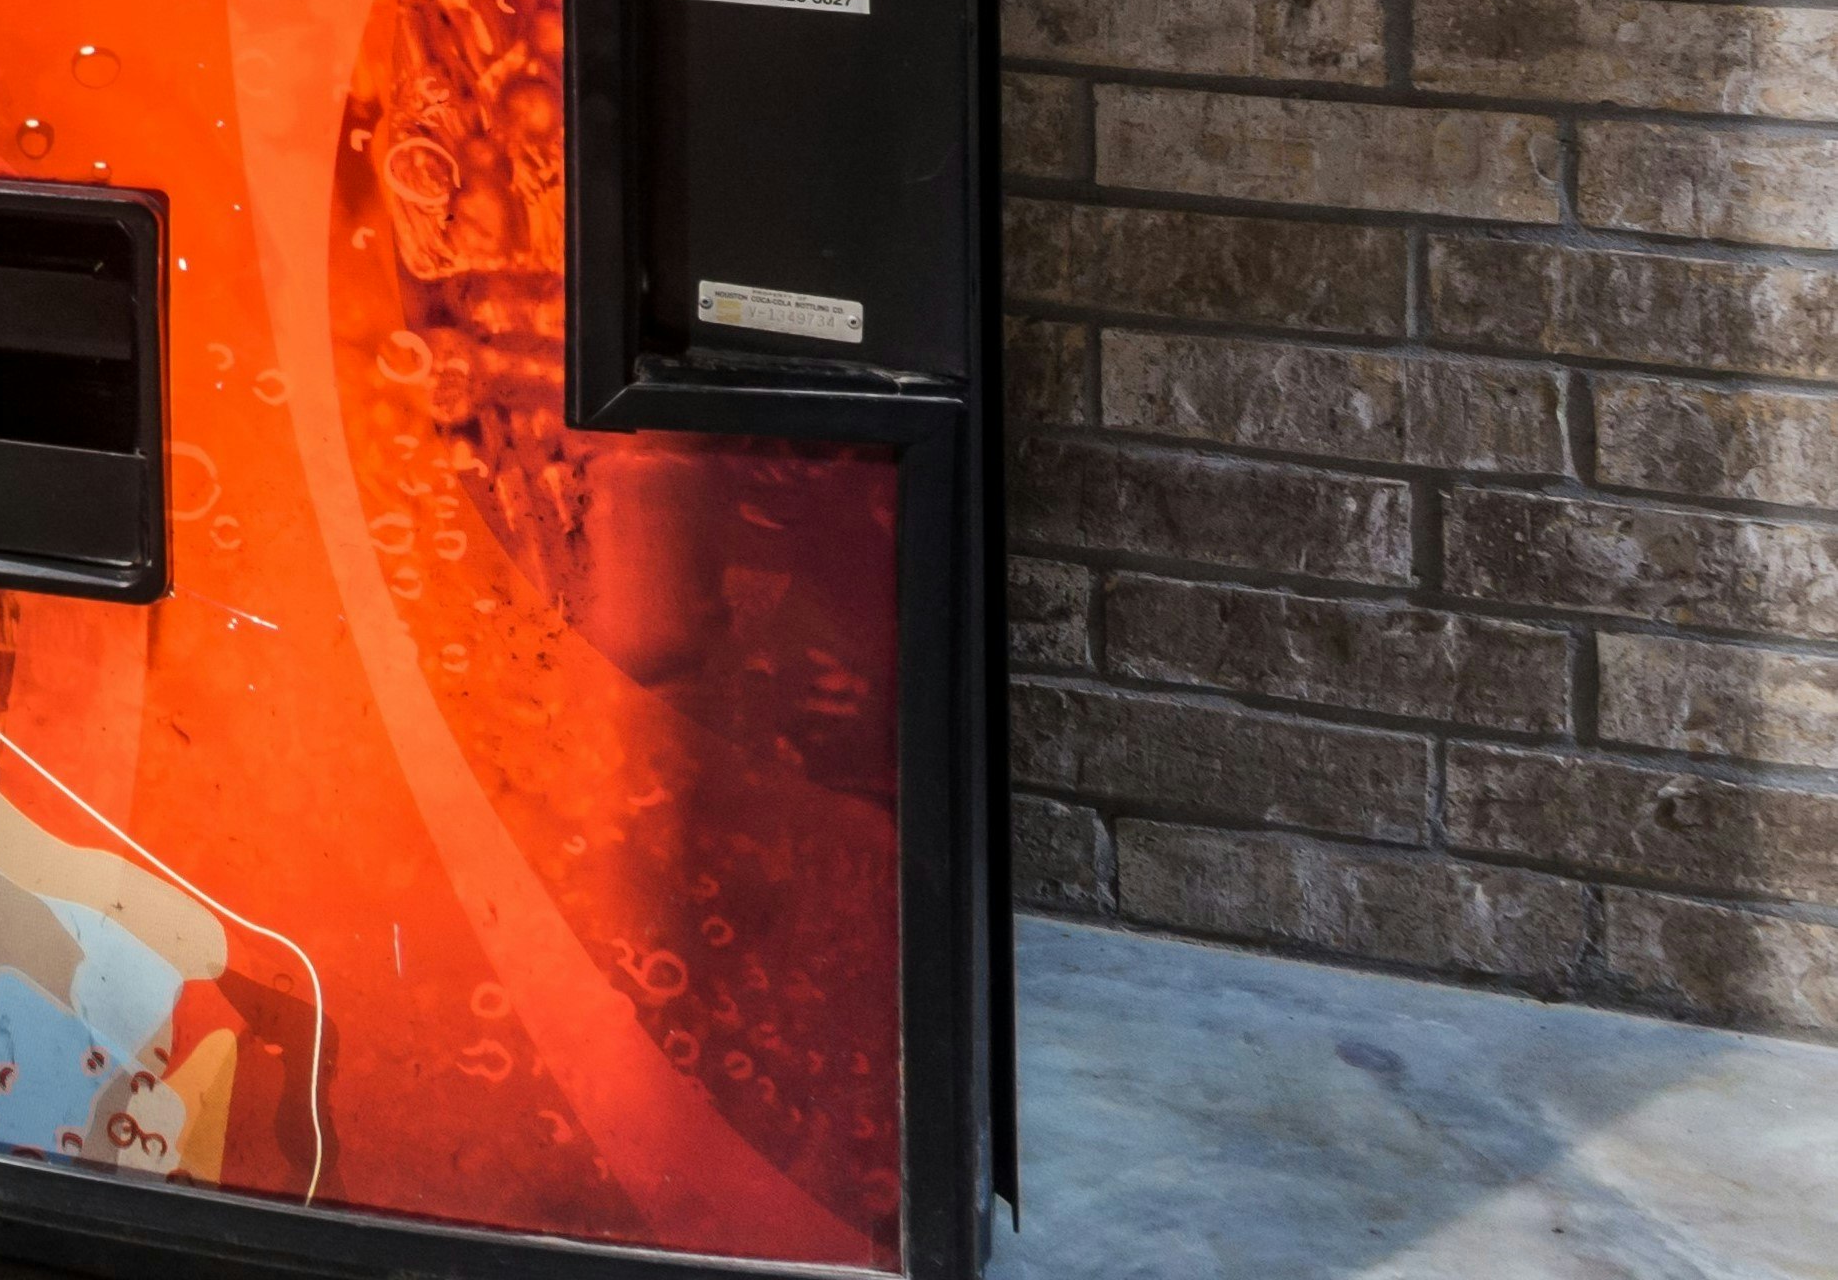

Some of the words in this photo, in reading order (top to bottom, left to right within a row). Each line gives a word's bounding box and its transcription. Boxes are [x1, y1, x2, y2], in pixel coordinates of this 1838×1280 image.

[714, 291, 748, 301] HOUSTON
[750, 295, 792, 308] COCA-COLA
[794, 301, 830, 313] BOTTLING
